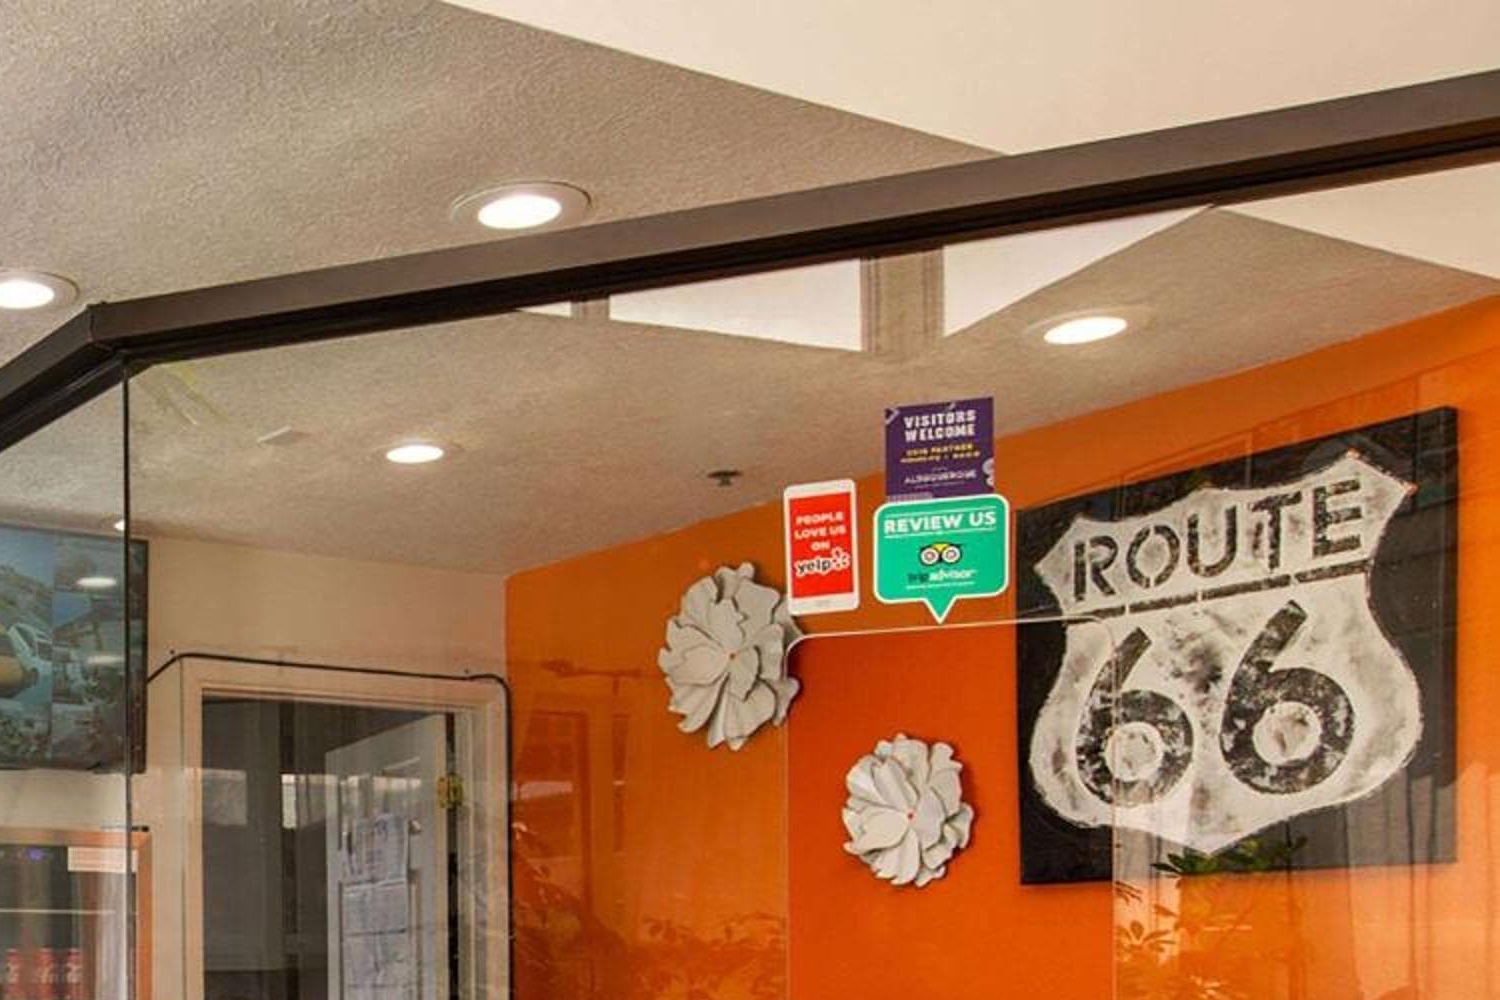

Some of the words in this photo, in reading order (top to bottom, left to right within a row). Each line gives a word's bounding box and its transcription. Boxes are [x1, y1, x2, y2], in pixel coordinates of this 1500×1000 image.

[903, 409, 976, 429] VISITORS
[904, 423, 975, 442] WELCOME
[795, 511, 844, 526] PEOPLE
[884, 513, 964, 535] REVIEW
[969, 511, 997, 527] US
[794, 527, 827, 541] LOVE
[829, 524, 848, 536] US
[1073, 478, 1363, 602] ROUTE
[810, 540, 831, 552] ON
[794, 555, 833, 578] yelp
[1075, 600, 1356, 808] 66
